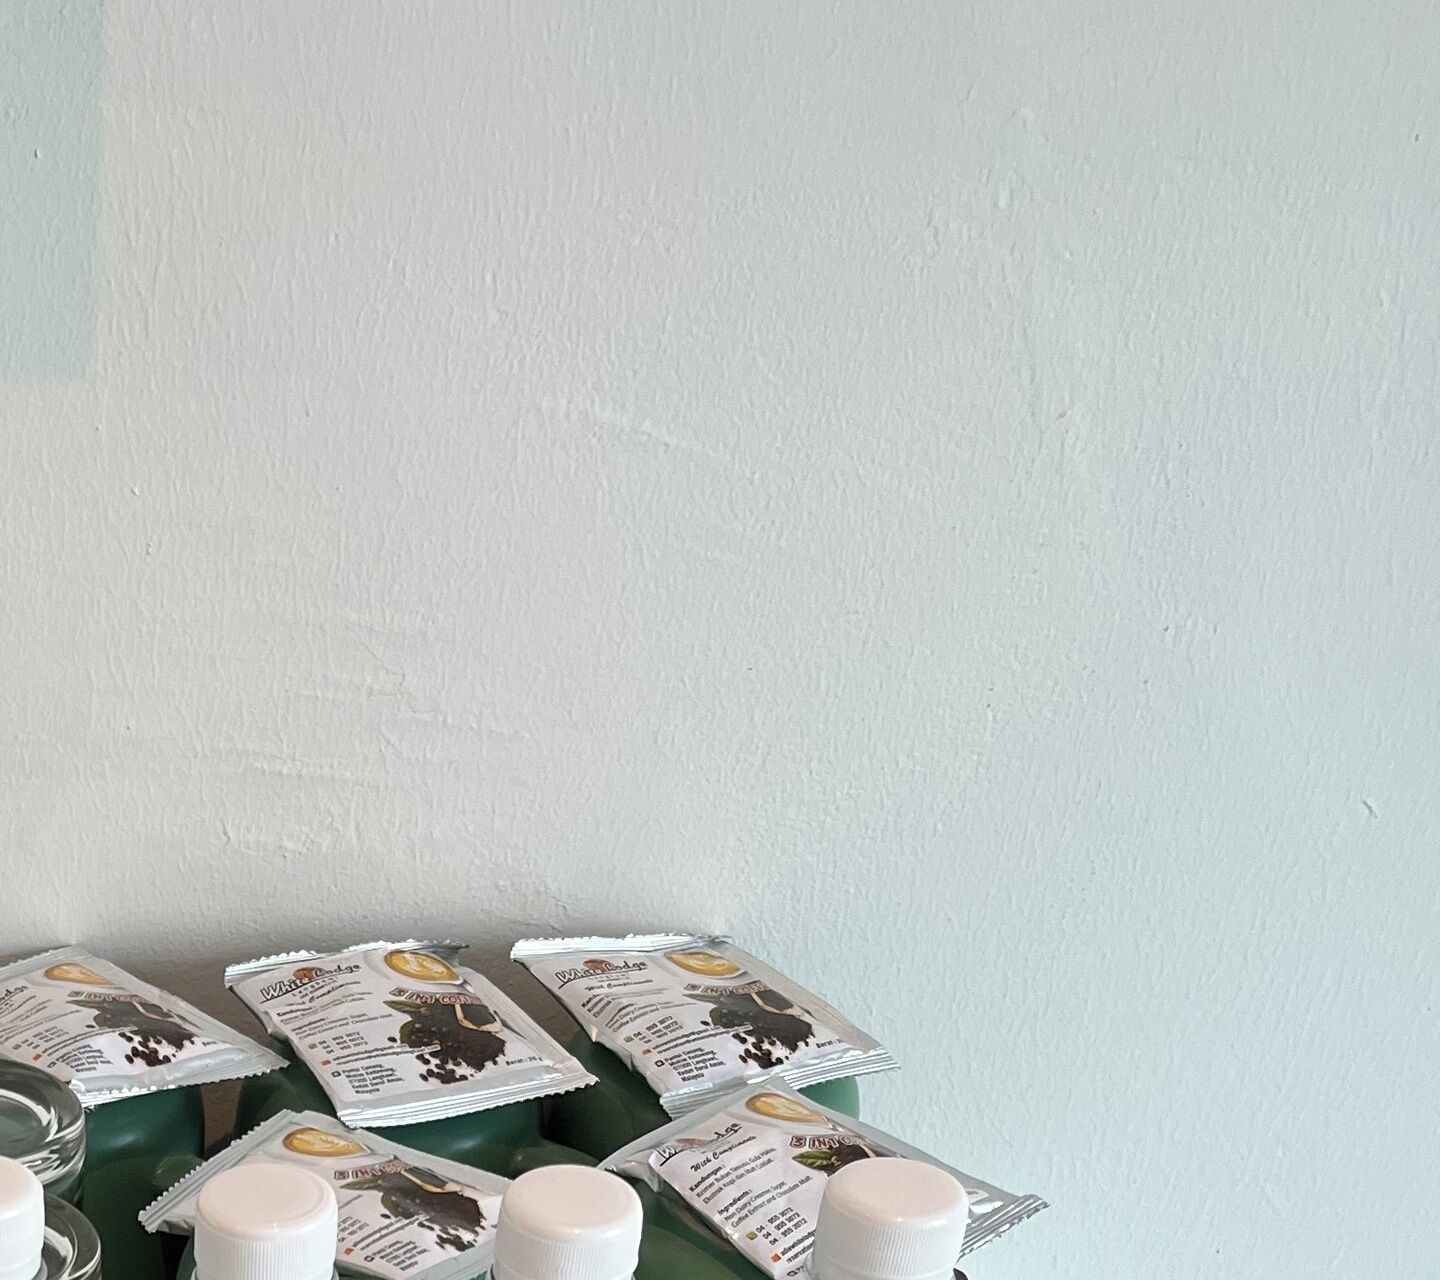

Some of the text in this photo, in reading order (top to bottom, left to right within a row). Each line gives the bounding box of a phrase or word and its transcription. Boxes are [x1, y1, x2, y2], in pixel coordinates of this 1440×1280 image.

[604, 960, 648, 974] Lodge
[260, 964, 361, 1001] White Lodge
